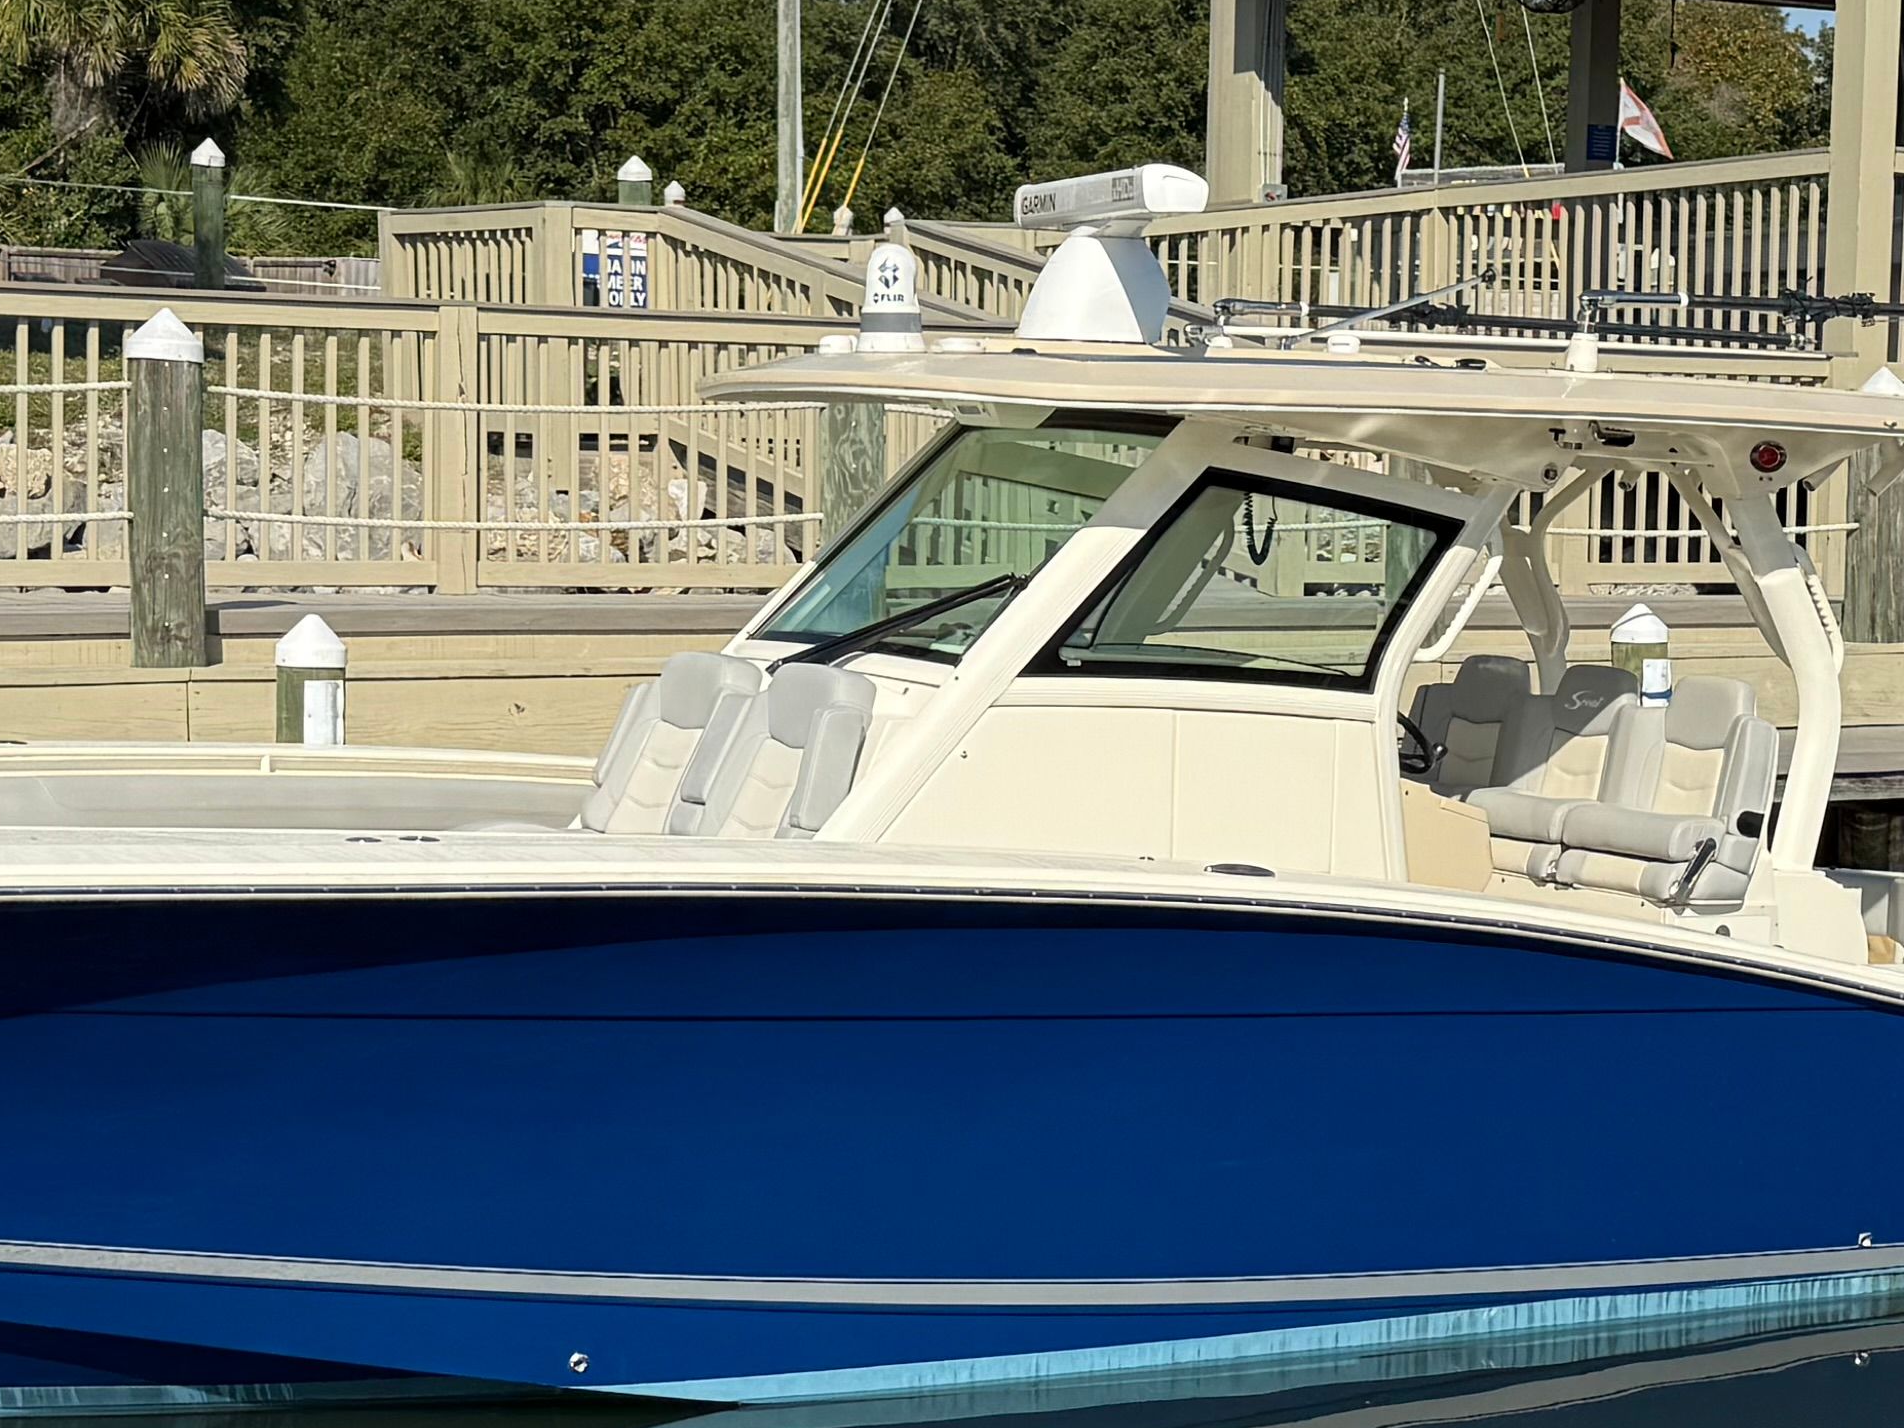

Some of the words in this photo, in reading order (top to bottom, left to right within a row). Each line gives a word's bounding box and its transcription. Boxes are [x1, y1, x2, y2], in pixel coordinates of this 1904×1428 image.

[1021, 192, 1057, 216] GARMIN
[609, 290, 646, 307] OLY
[880, 293, 905, 302] FLIR
